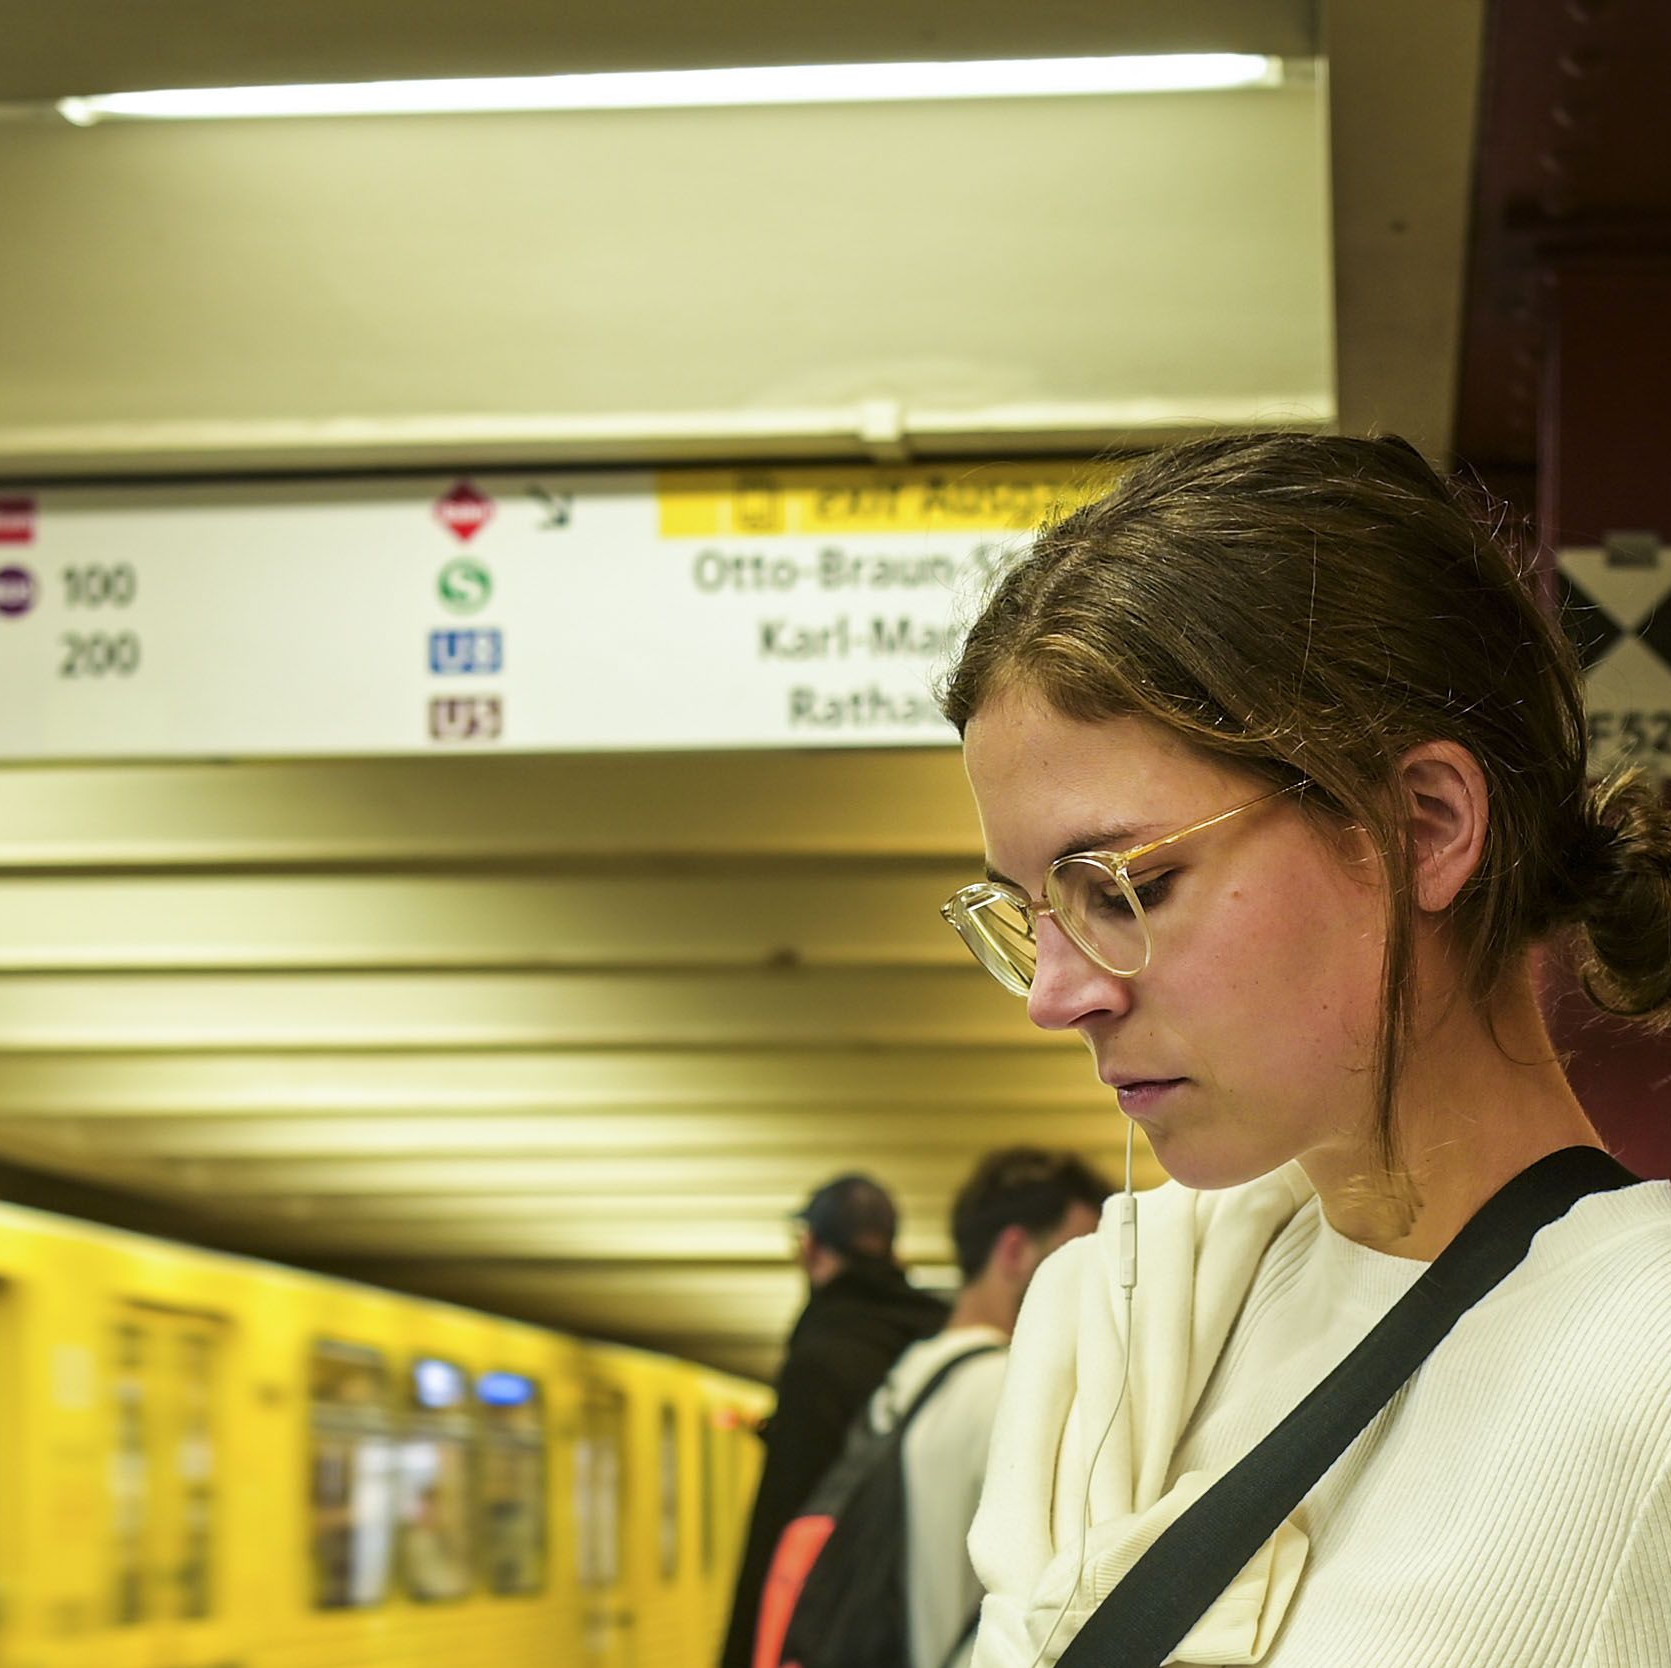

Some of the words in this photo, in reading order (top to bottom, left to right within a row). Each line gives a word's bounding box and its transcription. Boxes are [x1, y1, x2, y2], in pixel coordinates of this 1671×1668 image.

[61, 563, 137, 609] 100
[57, 631, 142, 679] 200
[758, 616, 958, 660] Karl-Mar
